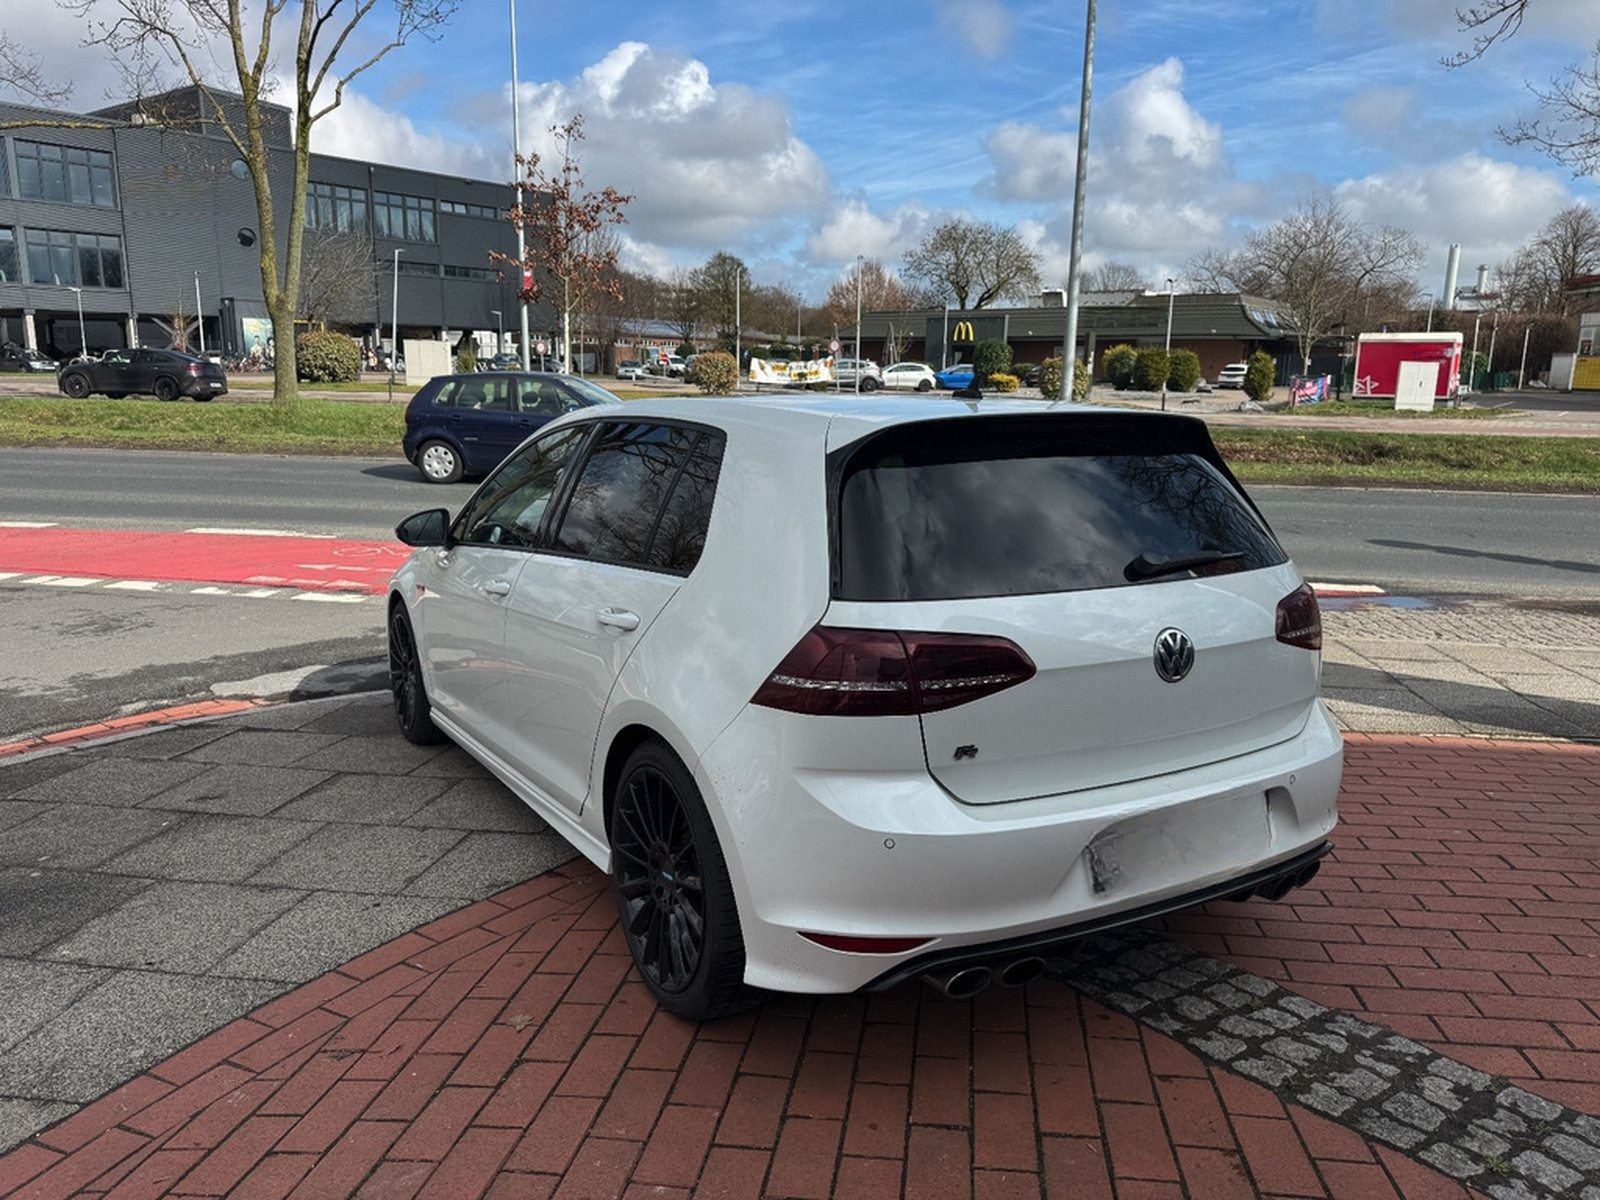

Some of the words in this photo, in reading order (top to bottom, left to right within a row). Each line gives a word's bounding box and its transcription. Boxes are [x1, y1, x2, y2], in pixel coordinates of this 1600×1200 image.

[953, 321, 974, 341] M
[1154, 627, 1194, 683] VW
[953, 744, 979, 761] R
